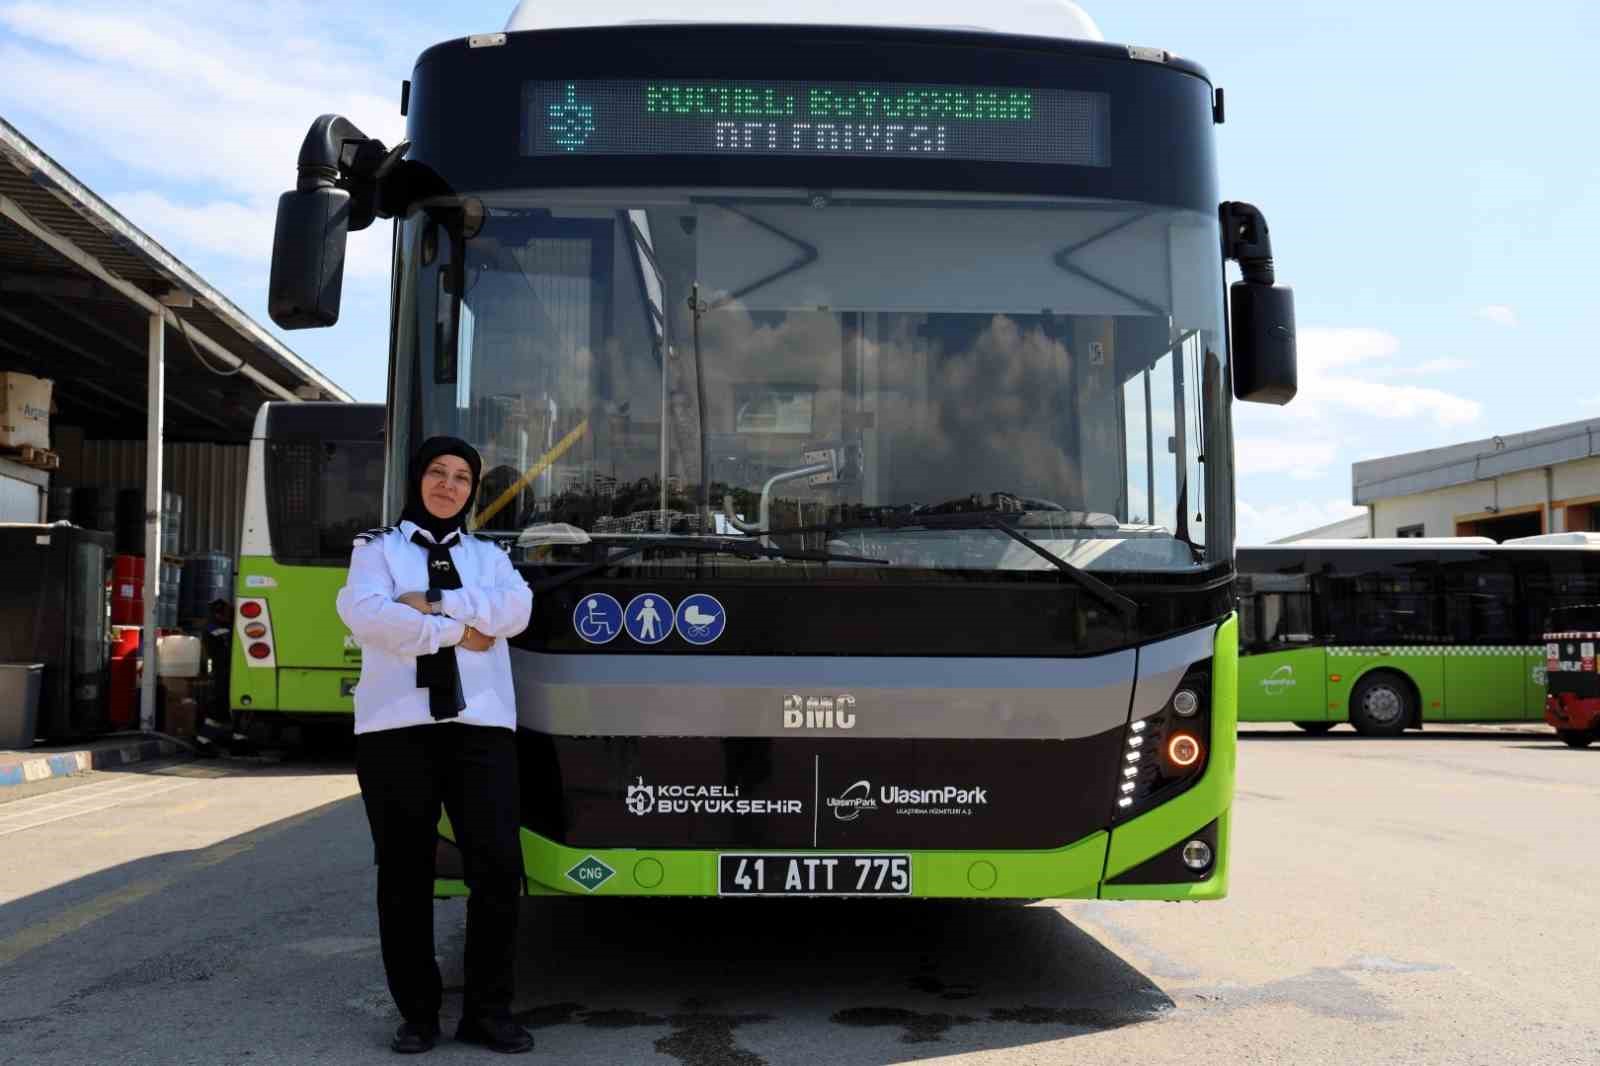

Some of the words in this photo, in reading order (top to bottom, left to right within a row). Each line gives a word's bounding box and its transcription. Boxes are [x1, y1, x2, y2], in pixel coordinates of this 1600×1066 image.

[783, 694, 856, 729] BMC
[579, 867, 602, 880] CNG
[734, 858, 765, 891] 41
[785, 858, 840, 891] ATT
[855, 858, 908, 892] 775
